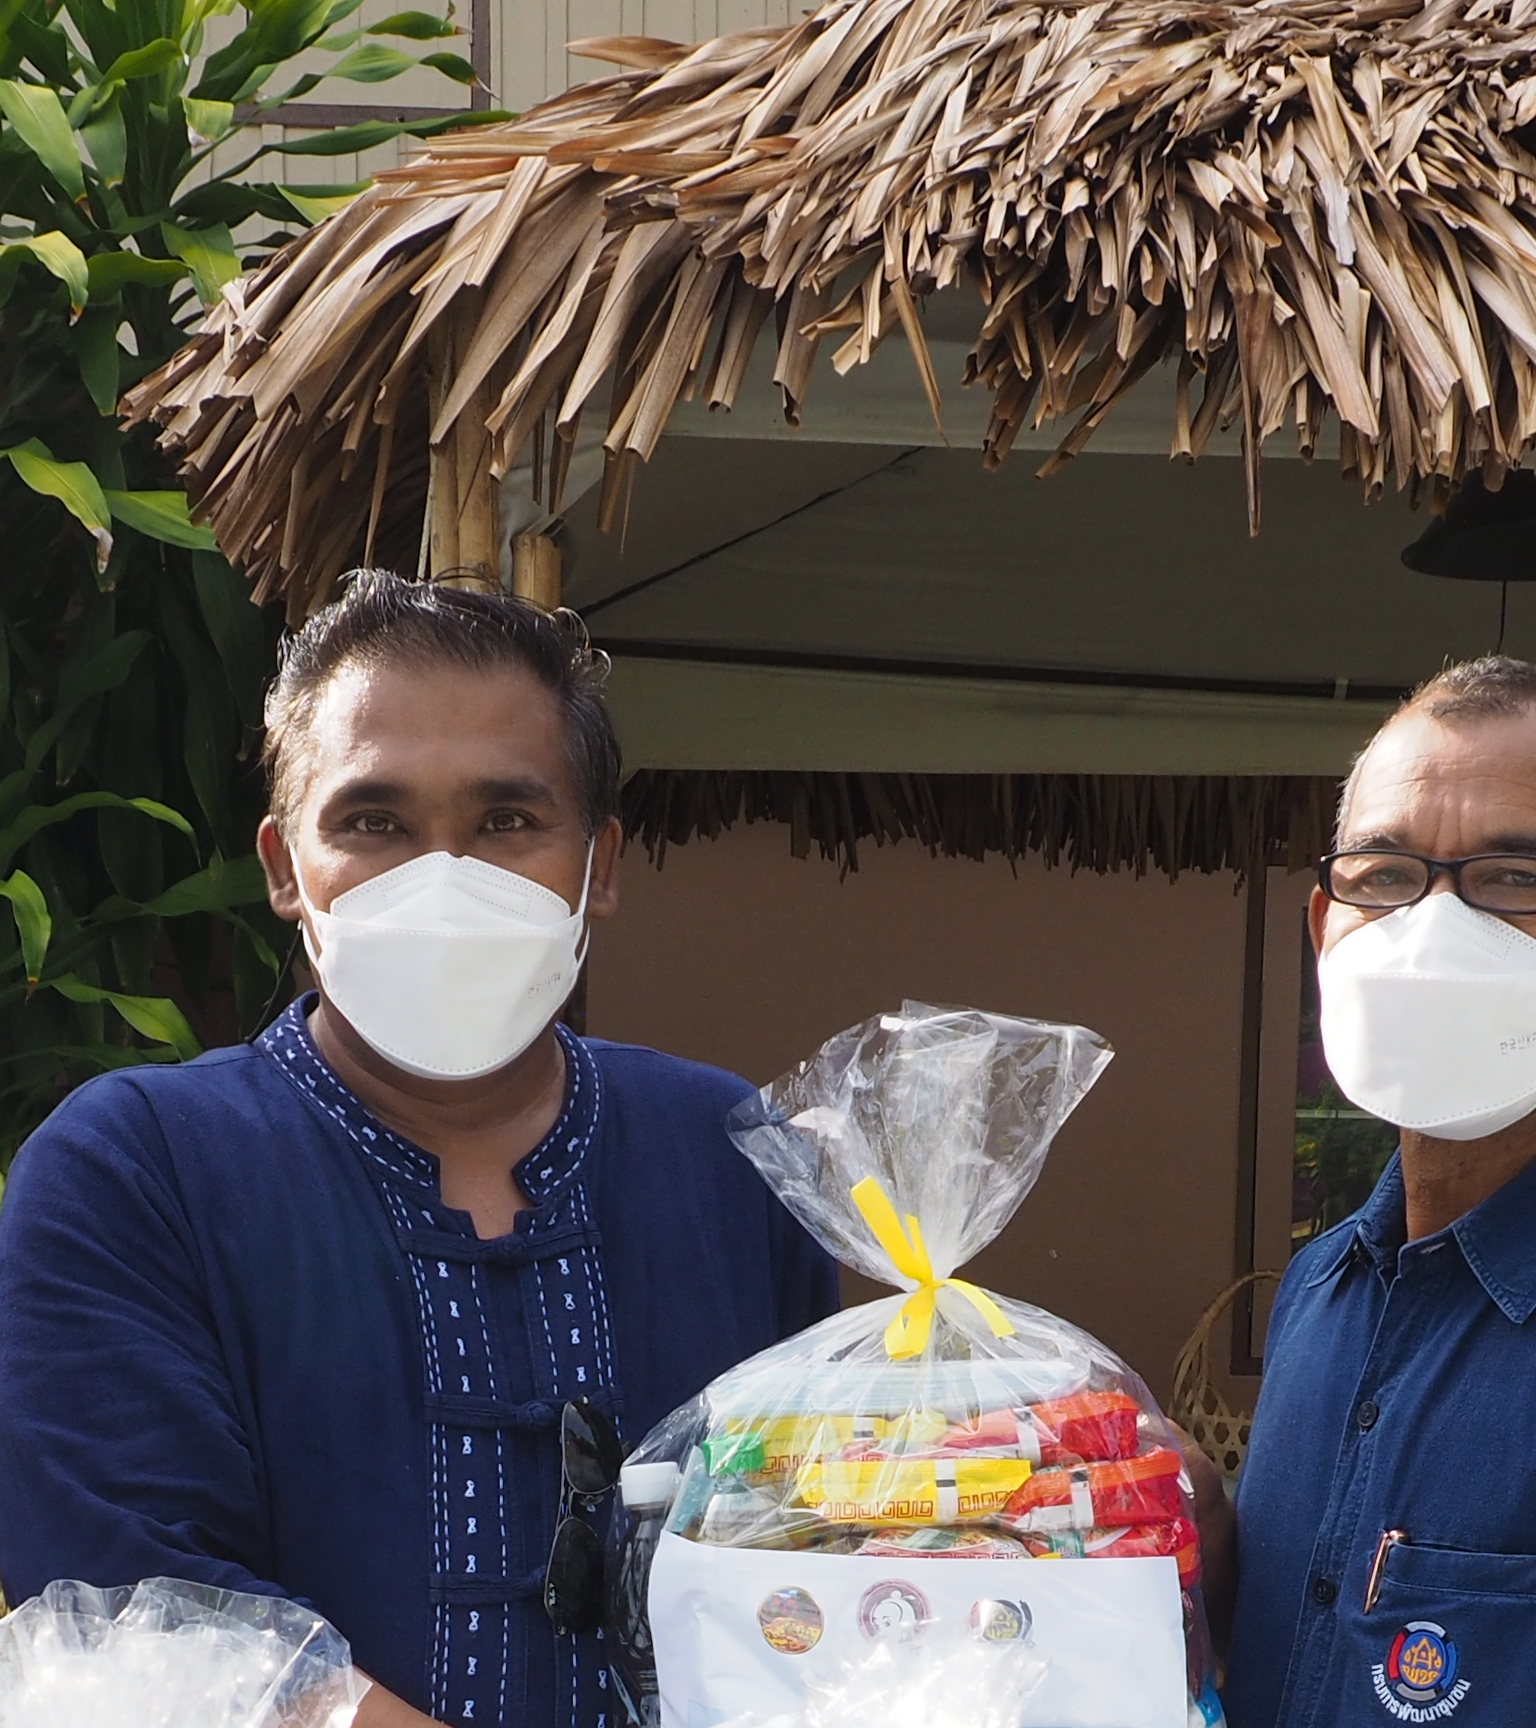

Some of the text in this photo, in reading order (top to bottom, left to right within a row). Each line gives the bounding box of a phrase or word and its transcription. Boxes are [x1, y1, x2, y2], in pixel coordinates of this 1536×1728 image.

[1371, 1663, 1471, 1724] กรมการพัฒนาชุมชน
